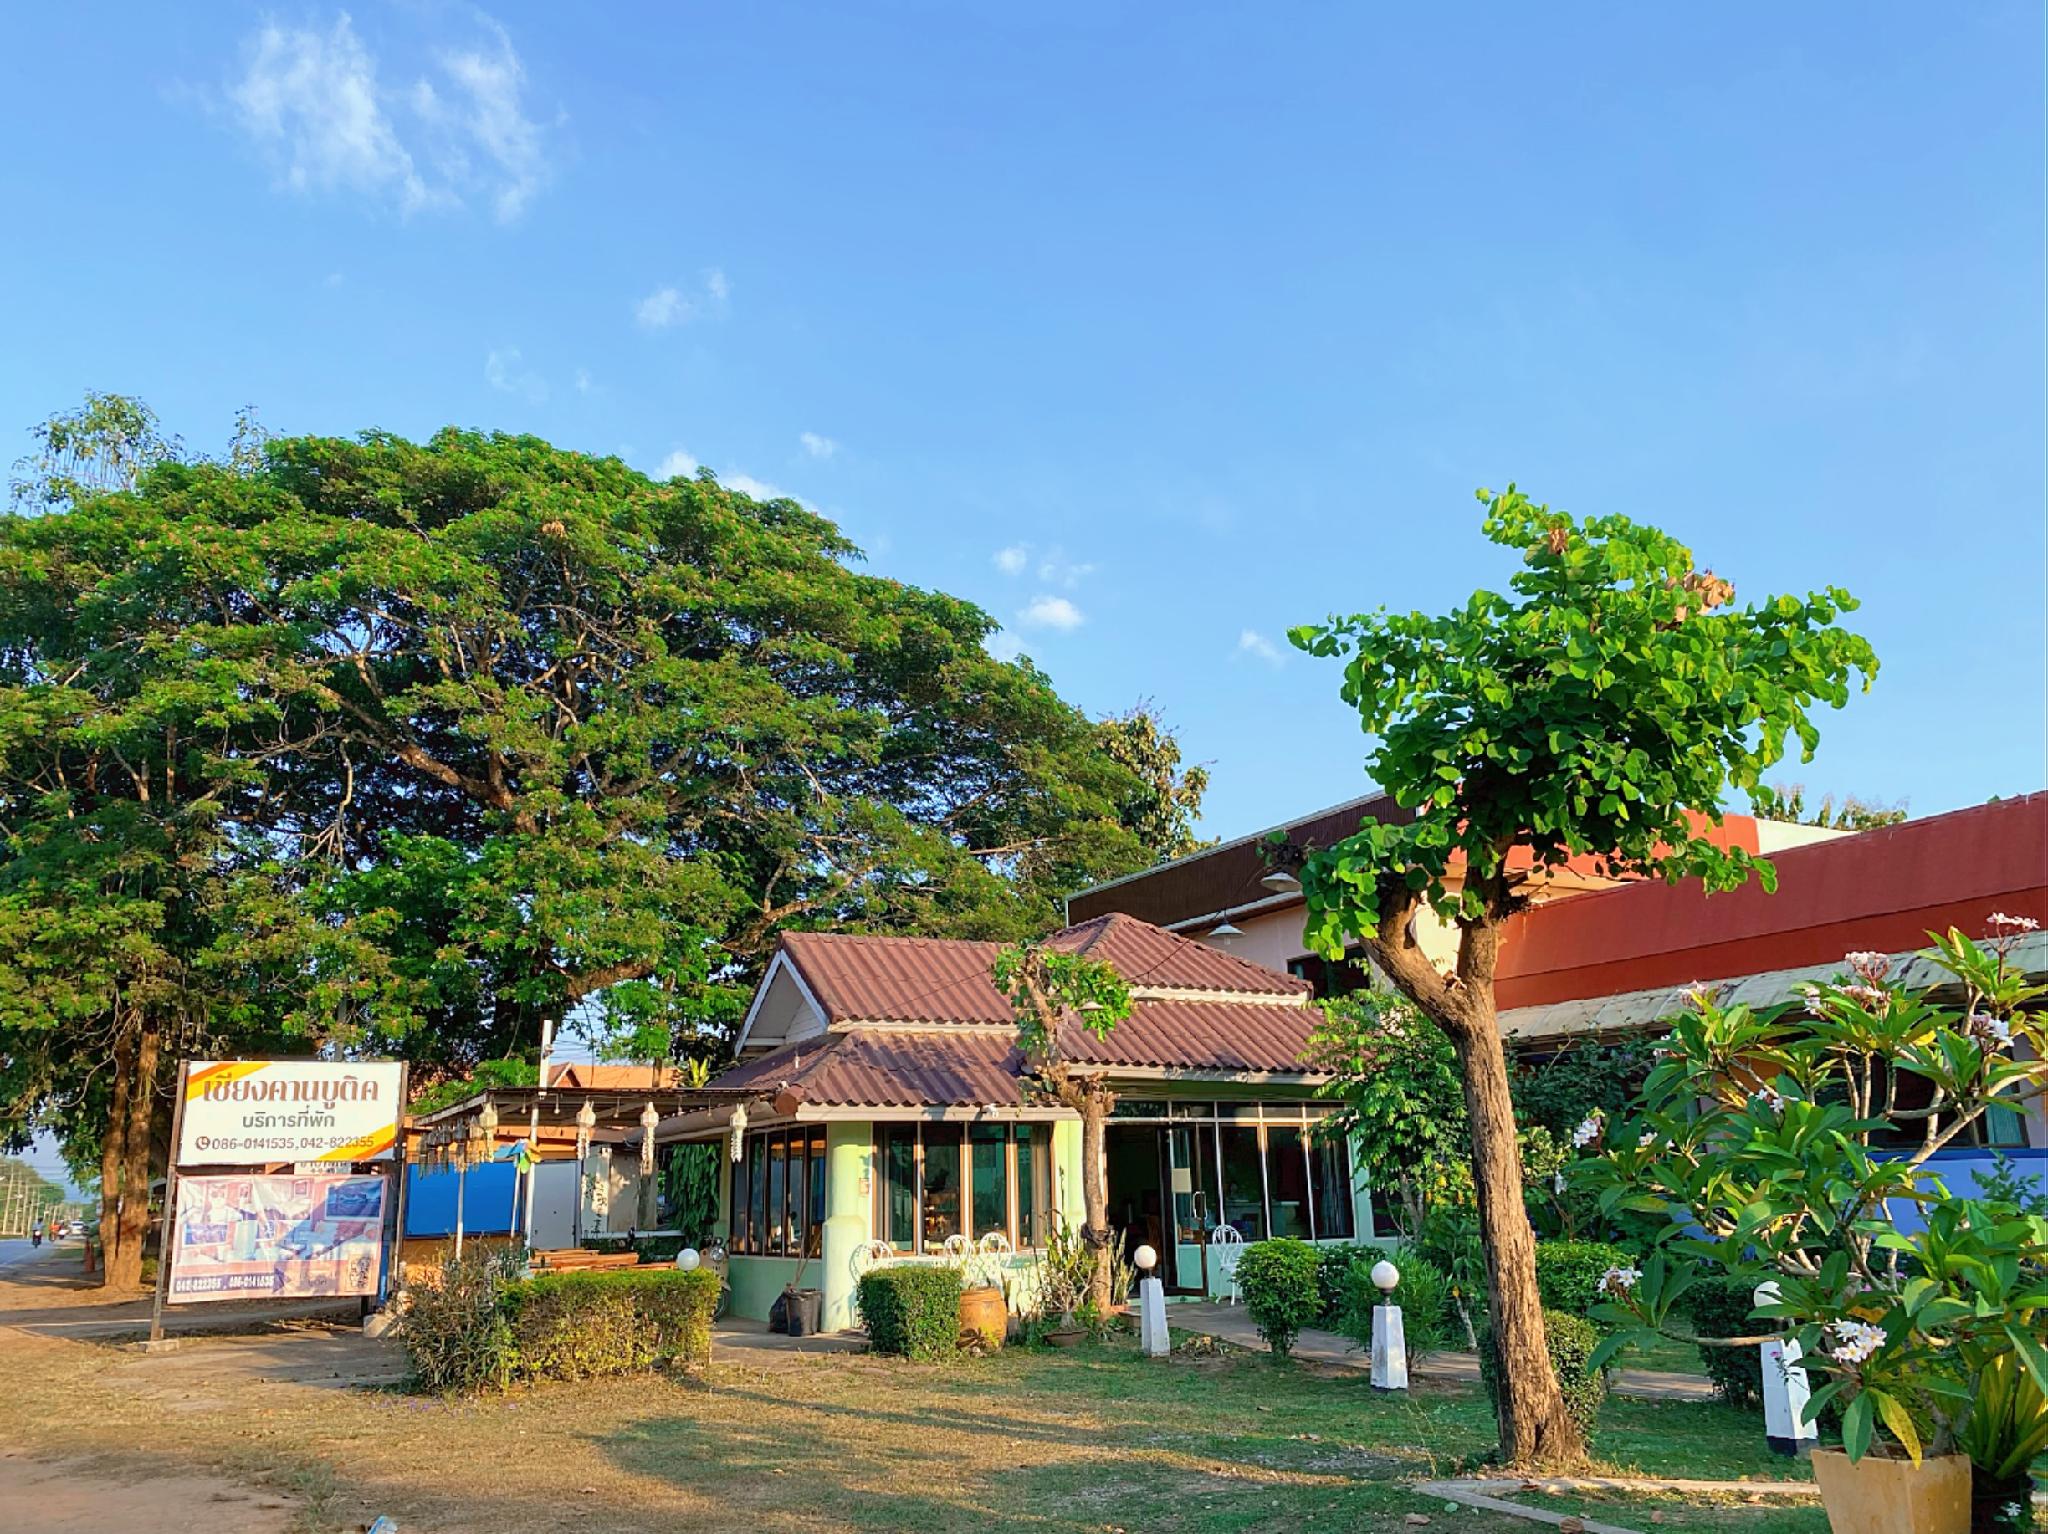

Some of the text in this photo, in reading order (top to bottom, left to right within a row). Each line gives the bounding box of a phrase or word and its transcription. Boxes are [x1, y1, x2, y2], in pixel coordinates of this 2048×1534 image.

[203, 1073, 379, 1110] เชียงคานบูติค
[242, 1105, 335, 1128] บริการที่พัก
